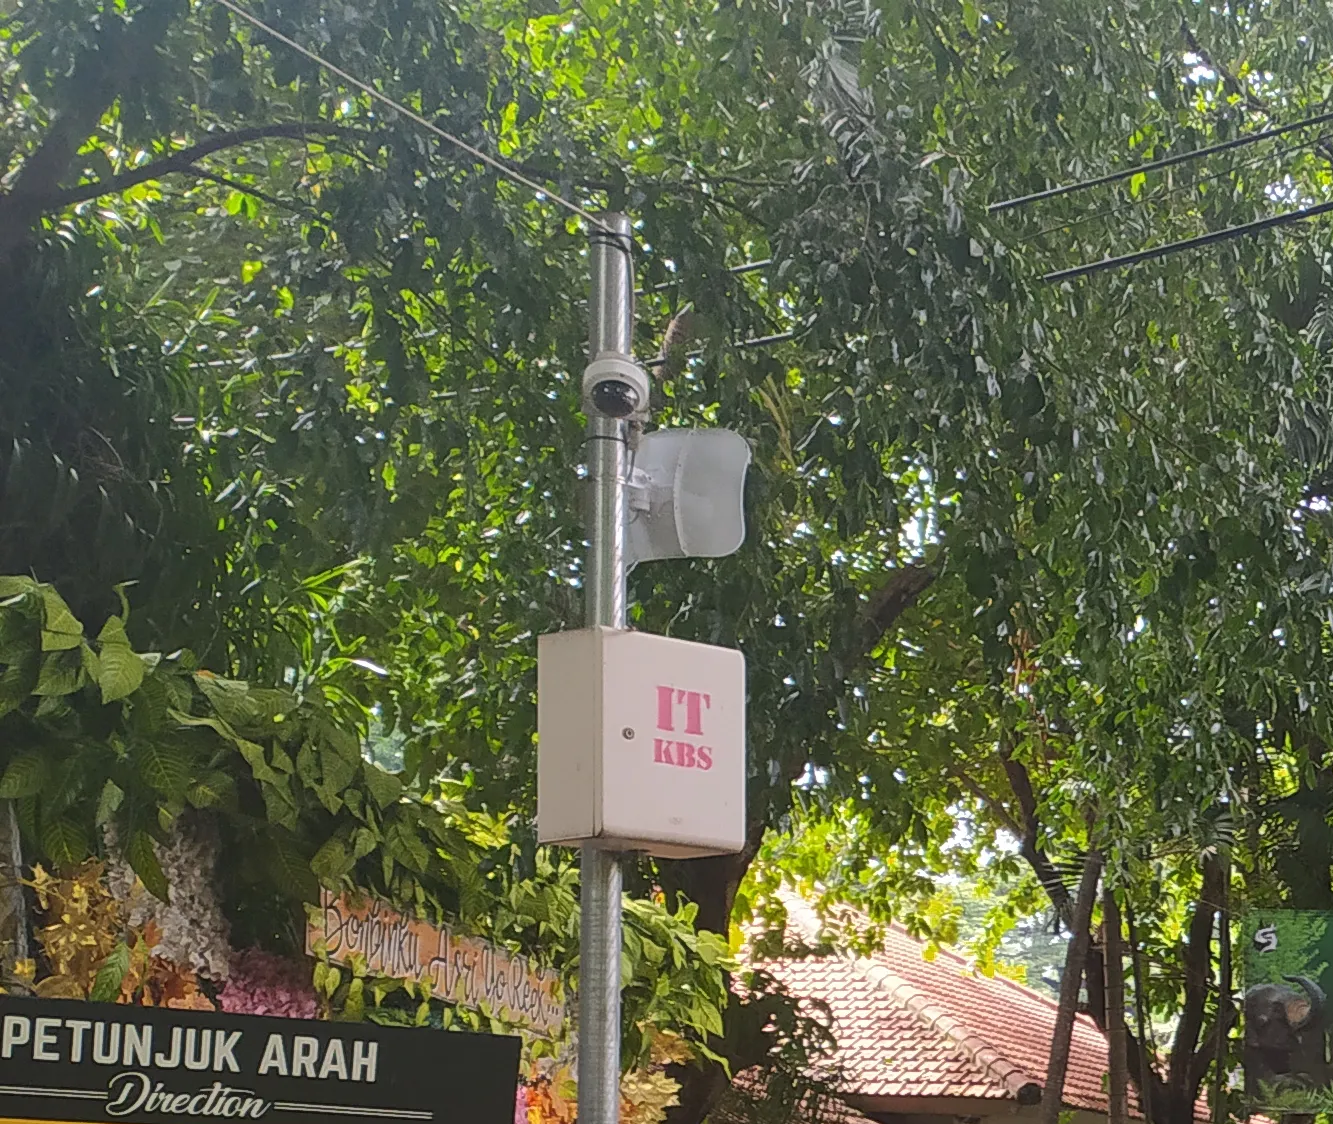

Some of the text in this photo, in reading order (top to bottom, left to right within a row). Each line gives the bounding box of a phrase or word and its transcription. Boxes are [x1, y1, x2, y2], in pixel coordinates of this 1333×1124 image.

[656, 685, 712, 736] IT
[653, 738, 713, 771] KBS
[1, 1015, 379, 1083] PETUNJUK ARAH
[105, 1072, 272, 1118] Direction
